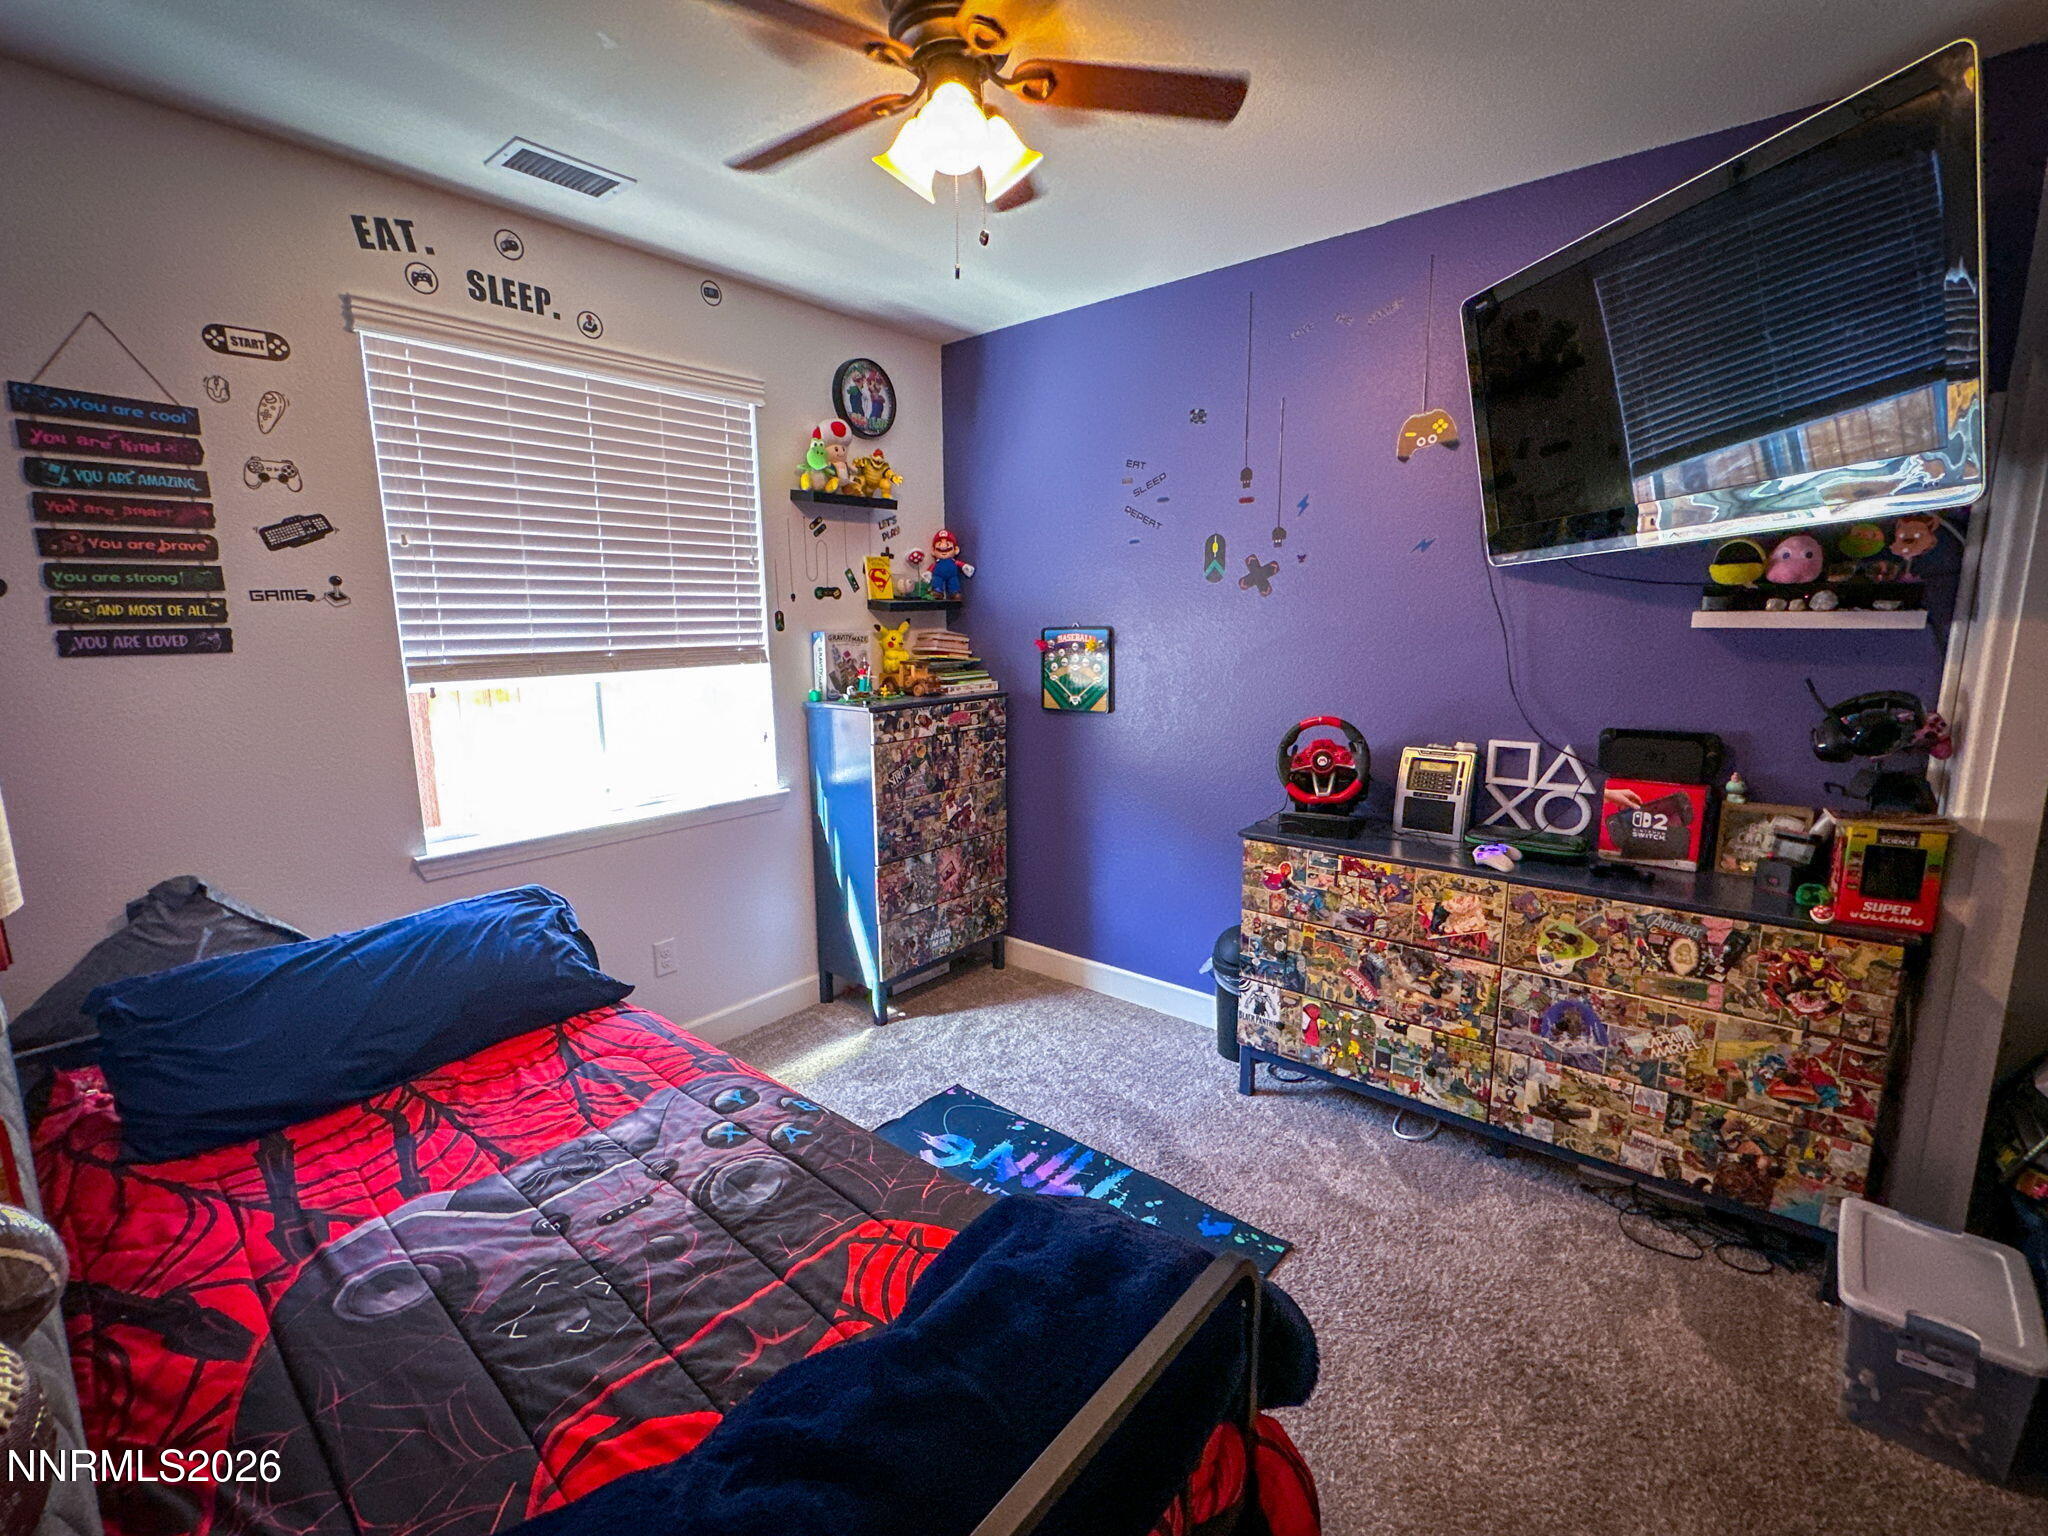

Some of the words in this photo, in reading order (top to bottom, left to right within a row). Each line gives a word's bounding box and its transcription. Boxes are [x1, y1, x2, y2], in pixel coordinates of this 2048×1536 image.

[351, 214, 435, 256] EAT.
[466, 269, 561, 321] SLEEP.
[230, 336, 264, 350] START
[69, 397, 107, 414] You
[112, 406, 145, 418] are
[149, 411, 189, 425] cool
[76, 436, 113, 450] are
[1126, 459, 1147, 470] EAT
[74, 468, 103, 486] YOU
[107, 473, 134, 485] ARE
[1133, 472, 1167, 497] SLEEP
[83, 504, 114, 516] are
[1124, 505, 1164, 530] REPEAT
[87, 537, 123, 550] You
[127, 539, 156, 550] are
[52, 571, 88, 583] You
[91, 573, 122, 583] are
[249, 589, 309, 602] GAME
[96, 604, 124, 617] AND
[128, 604, 163, 617] MOST
[167, 604, 184, 617] OF
[73, 635, 108, 649] YOU
[113, 635, 141, 649] ARE
[146, 634, 189, 648] LOVED
[1632, 832, 1666, 841] SWITCH
[1863, 901, 1912, 916] SUPER
[1646, 913, 1701, 938] AVENGERS
[1849, 912, 1924, 927] VOLCANO
[1342, 968, 1374, 1002] SPIDER-MAN
[1255, 1013, 1279, 1028] PANTHE
[1651, 1038, 1703, 1060] MARVEL
